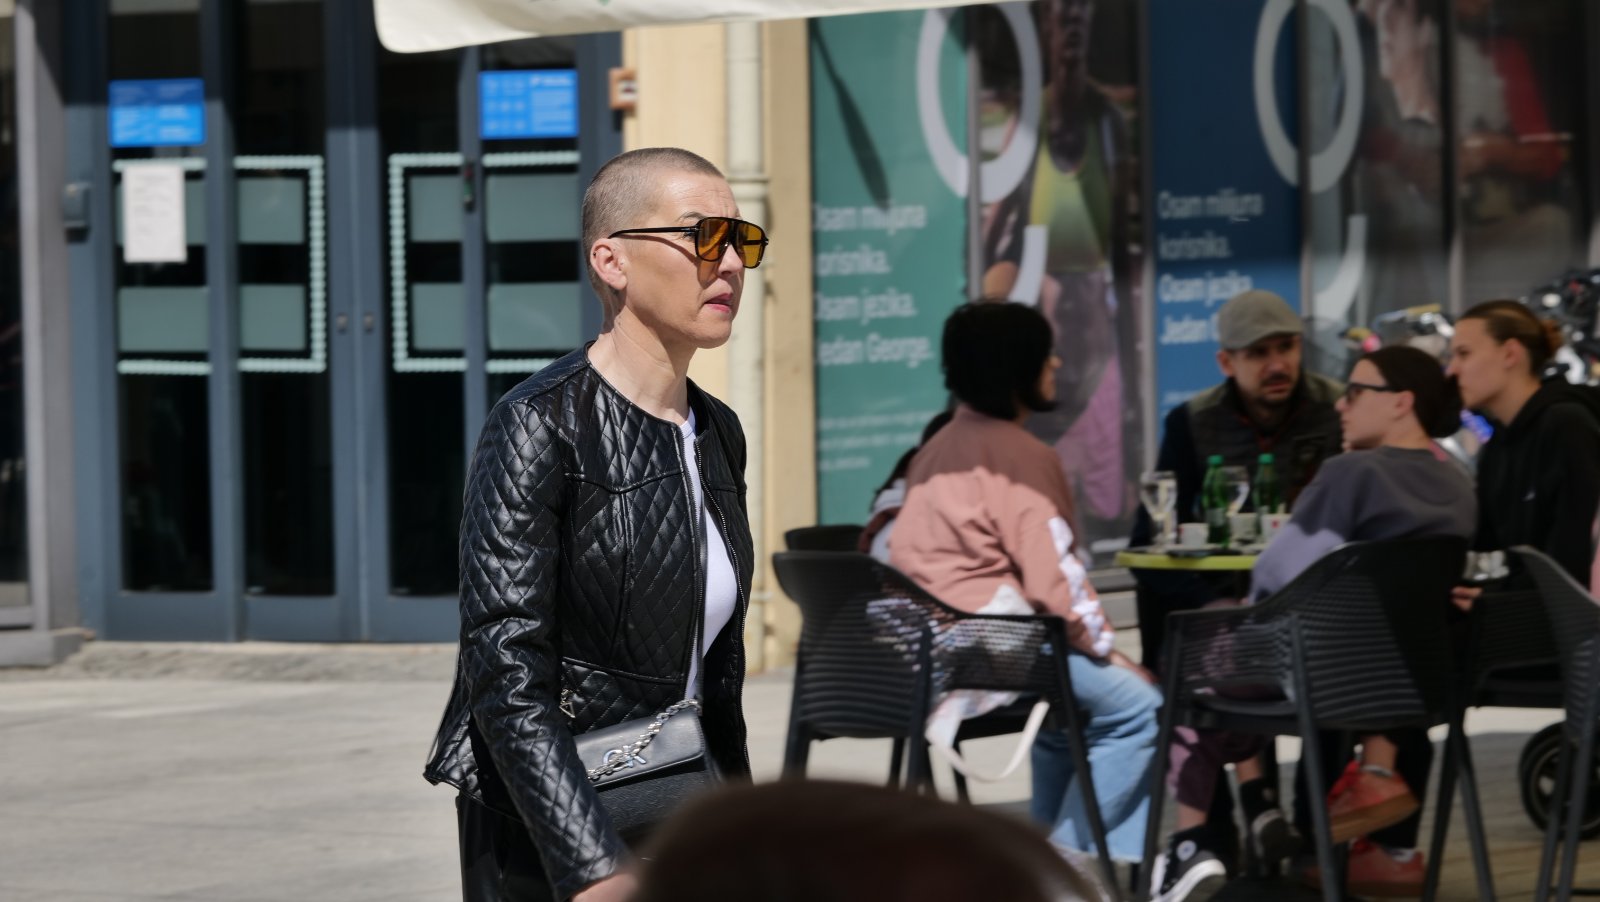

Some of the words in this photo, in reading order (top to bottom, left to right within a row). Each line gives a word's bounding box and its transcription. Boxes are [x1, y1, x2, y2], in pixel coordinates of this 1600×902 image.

[815, 245, 890, 277] orisnika.
[815, 336, 863, 366] edan
[866, 333, 934, 368] George.
